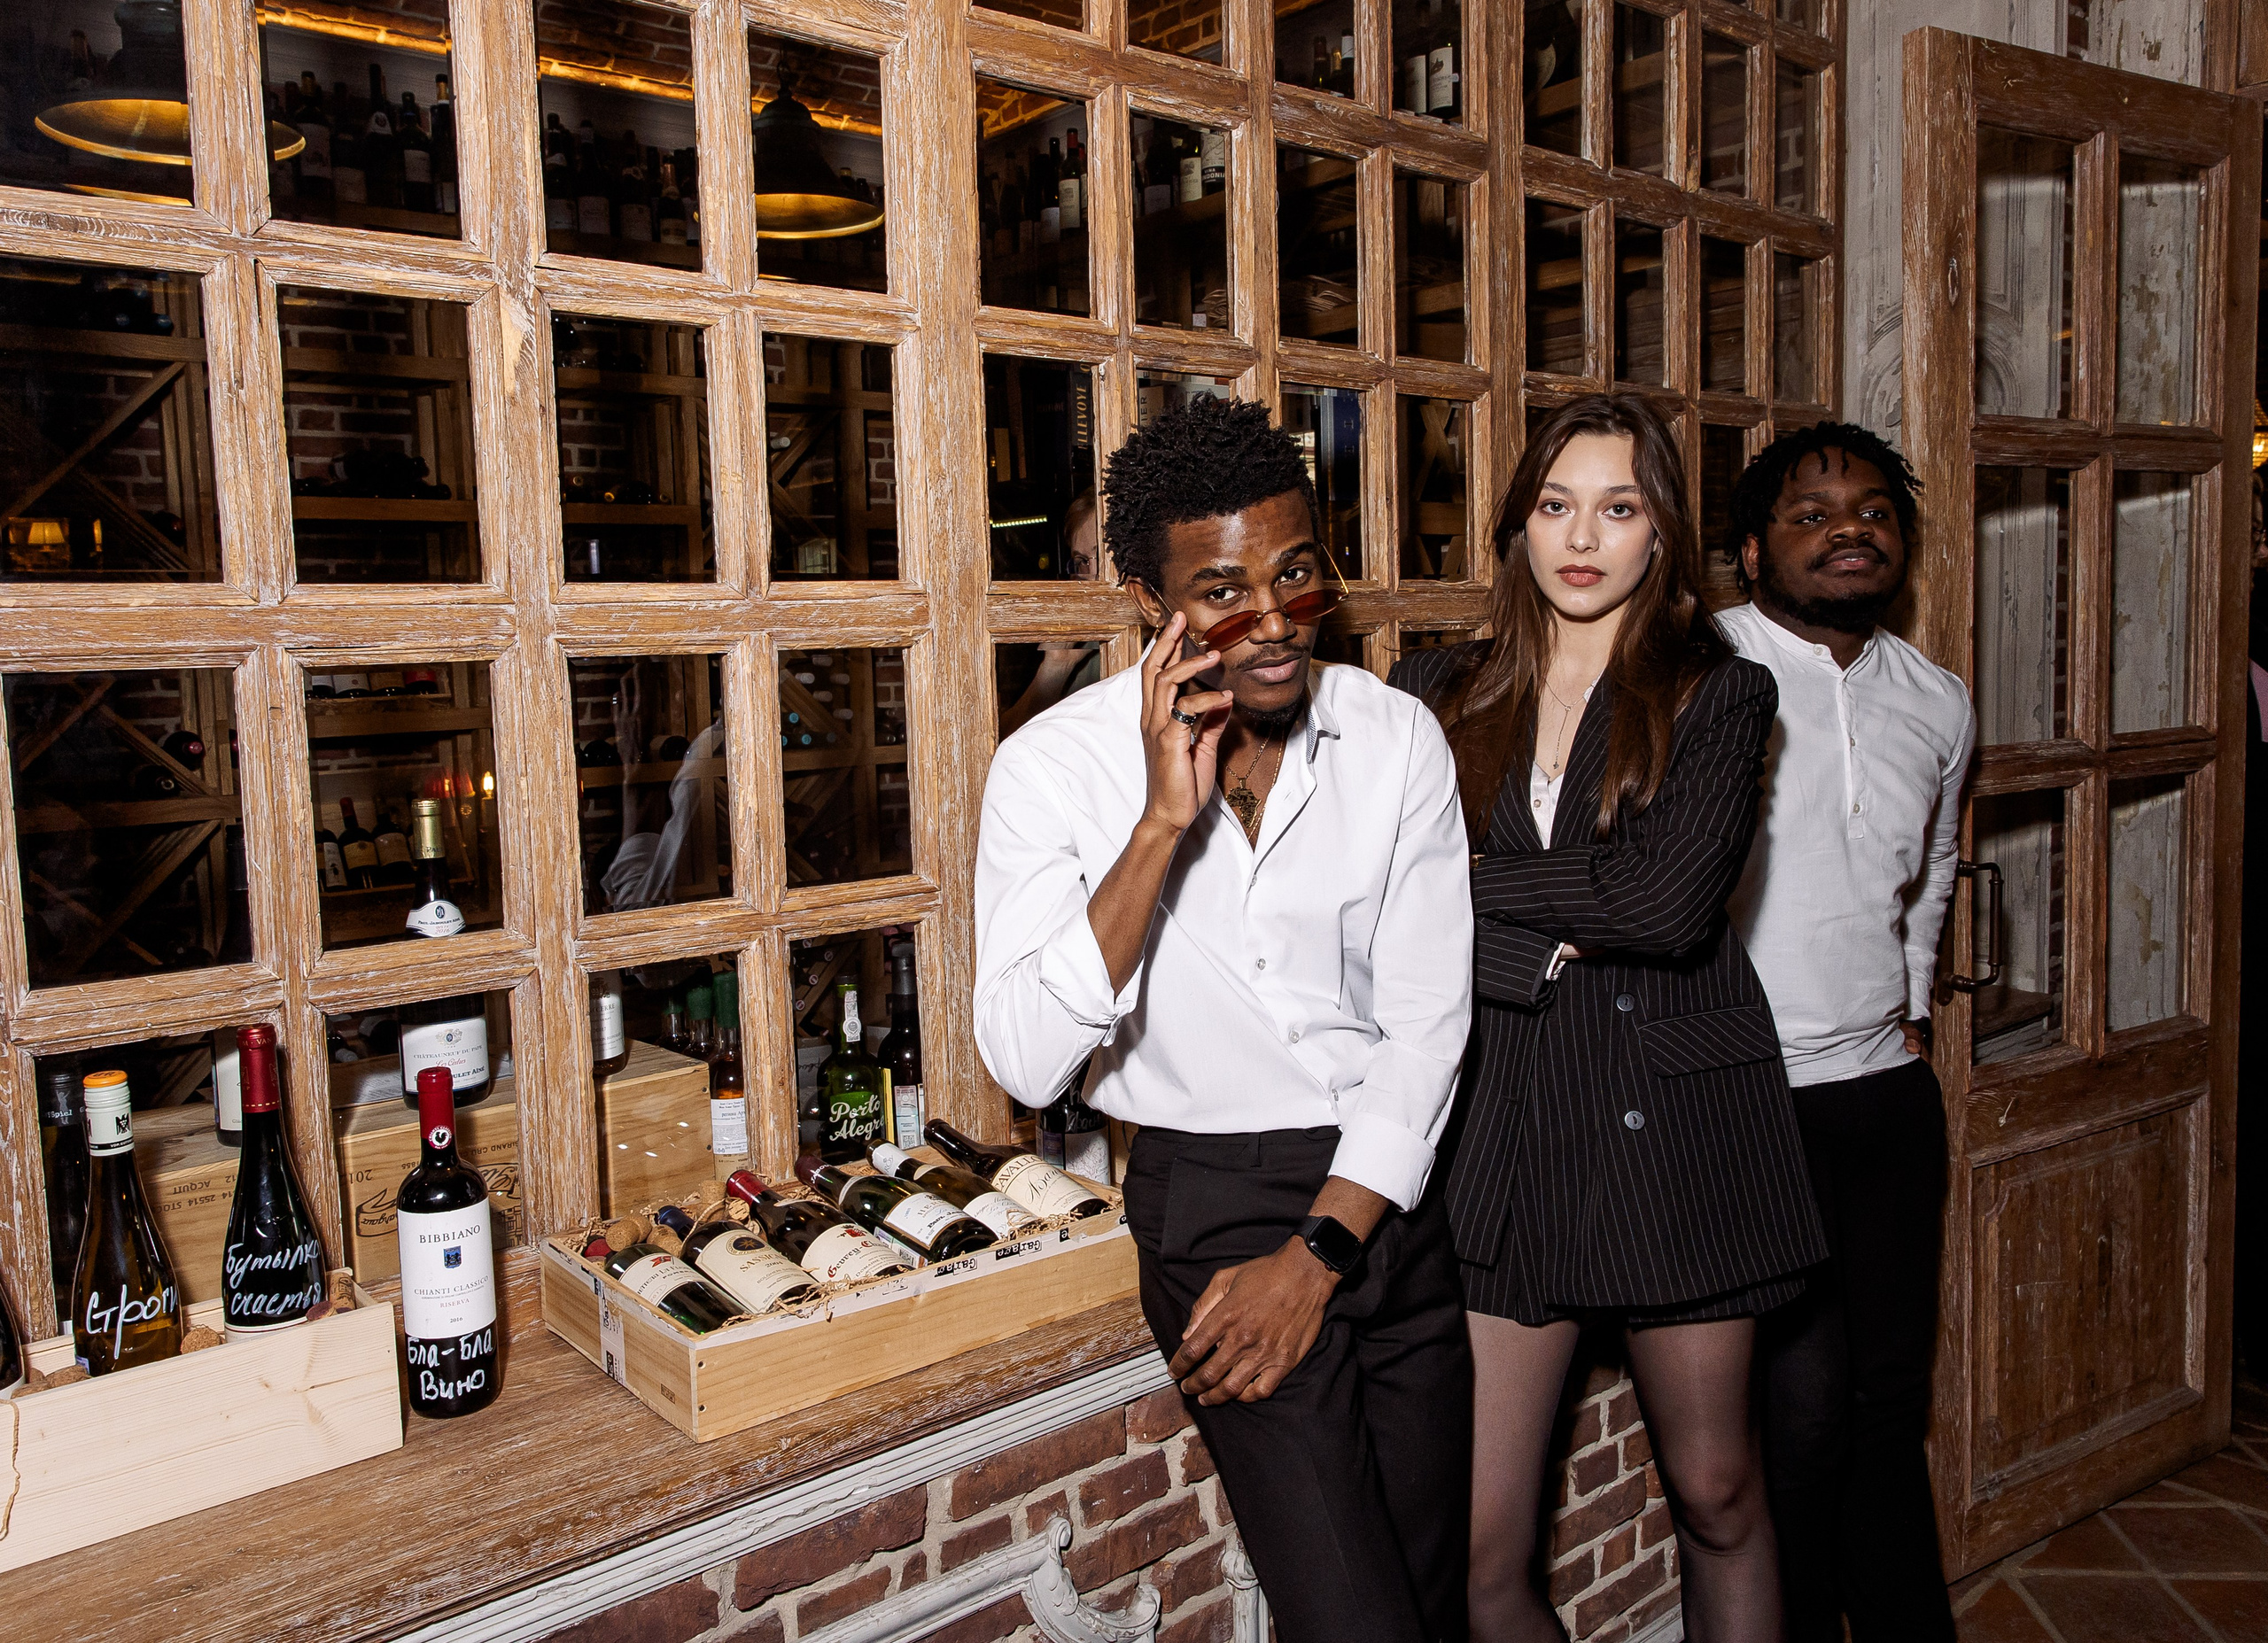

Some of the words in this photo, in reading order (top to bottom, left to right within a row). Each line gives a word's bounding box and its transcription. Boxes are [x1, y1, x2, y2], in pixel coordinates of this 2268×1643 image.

[829, 1094, 882, 1123] Porto
[828, 1113, 884, 1142] Alegre
[187, 1194, 216, 1207] 25514
[419, 1224, 481, 1244] BIBBIANO
[996, 1239, 1043, 1259] Garage
[414, 1287, 450, 1296] CHIANTI
[453, 1275, 489, 1292] CLASSICO
[439, 1298, 470, 1308] RISERVA
[420, 1369, 485, 1400] Вино
